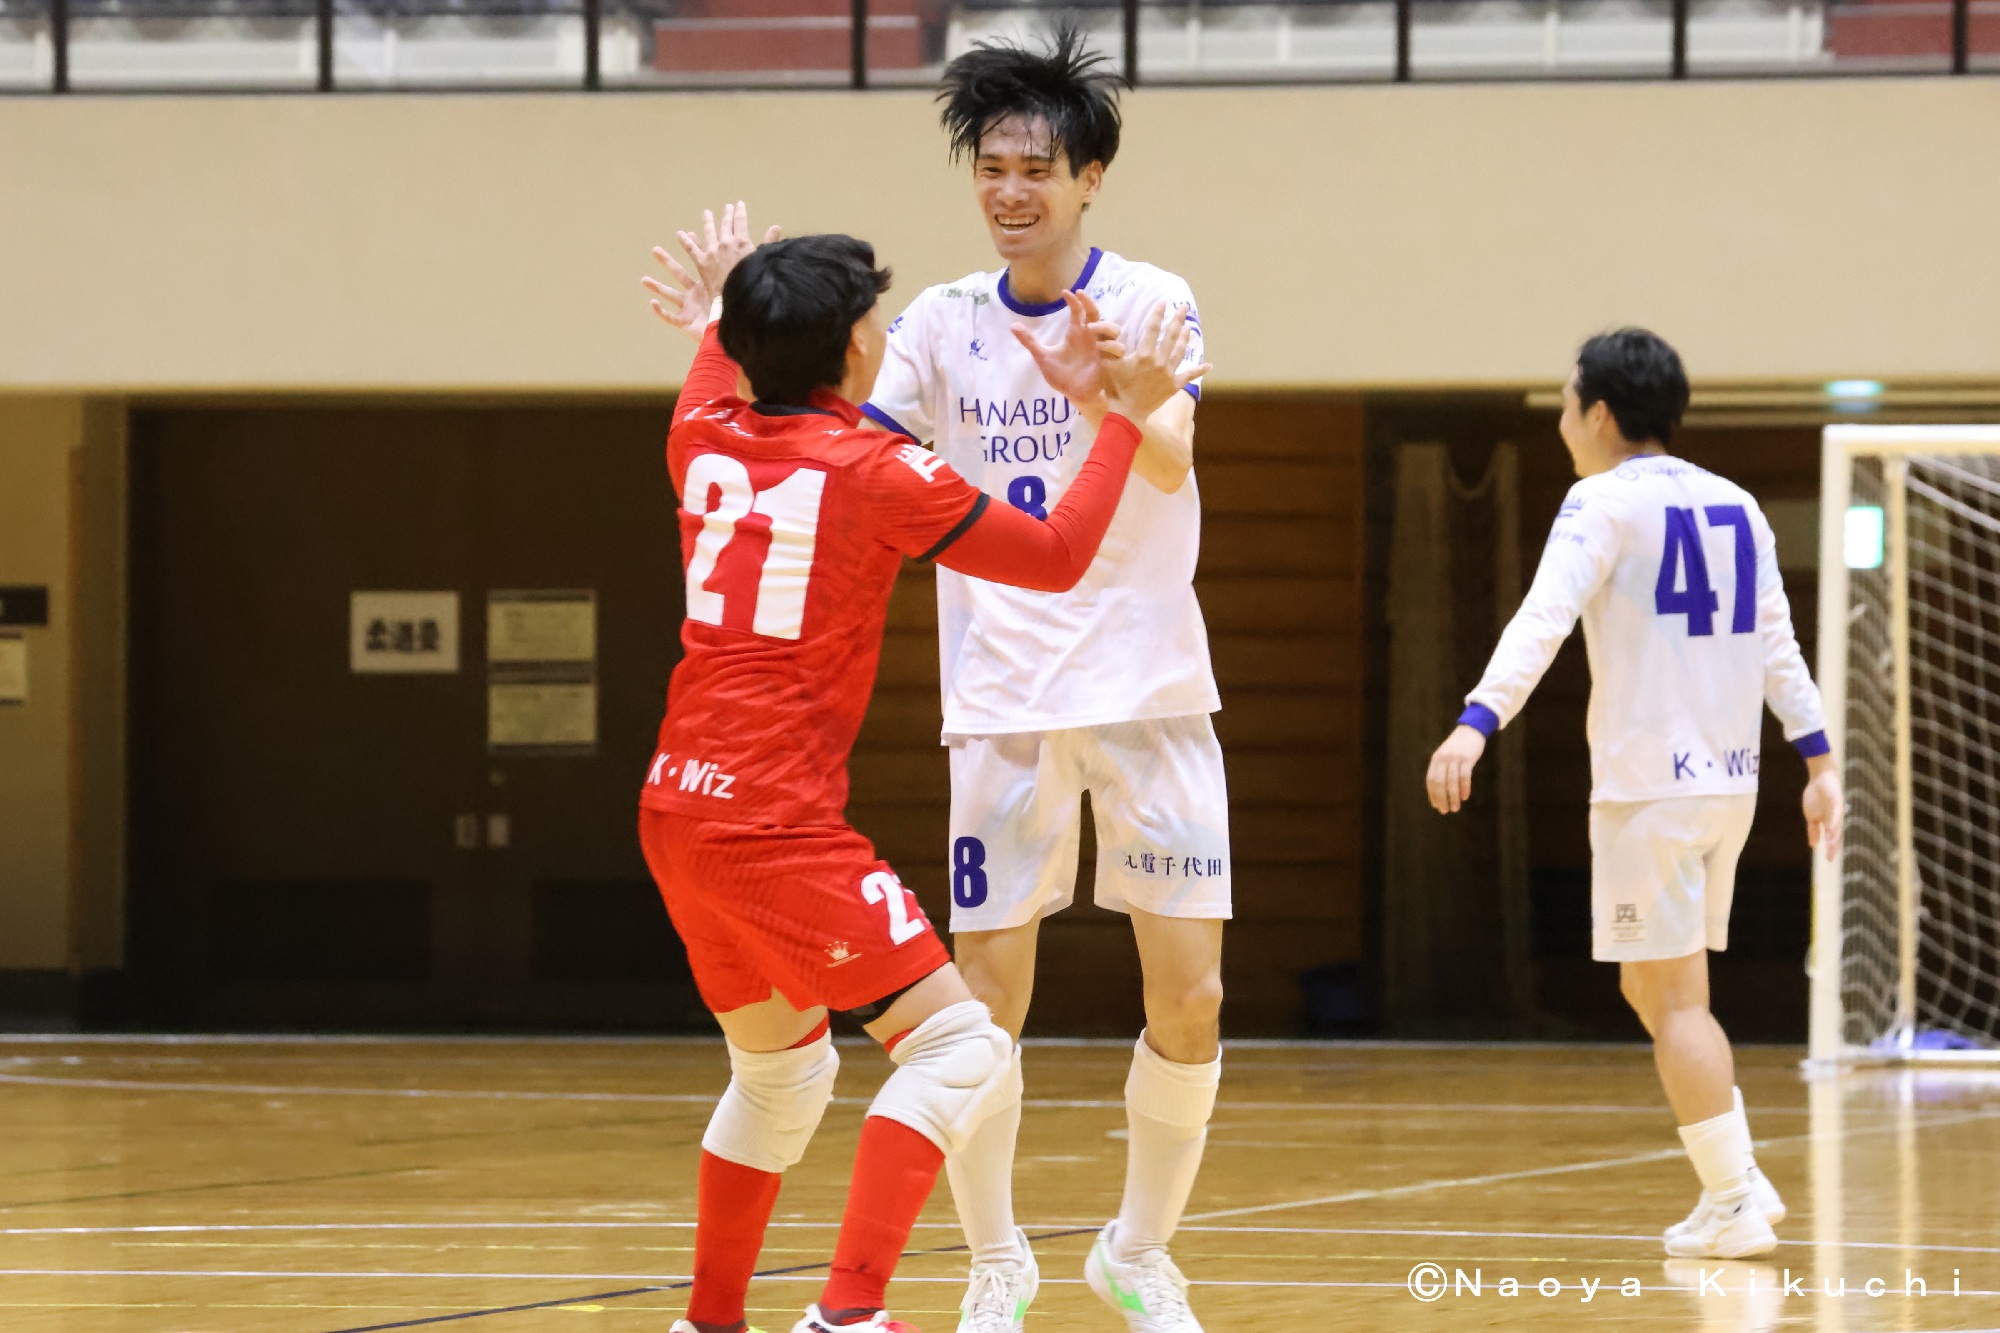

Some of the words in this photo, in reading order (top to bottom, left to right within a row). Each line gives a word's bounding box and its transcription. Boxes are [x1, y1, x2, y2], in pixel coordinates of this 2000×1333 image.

[683, 453, 827, 640] 21
[1007, 475, 1048, 521] 8
[1655, 504, 1757, 637] 47
[953, 836, 988, 908] 8
